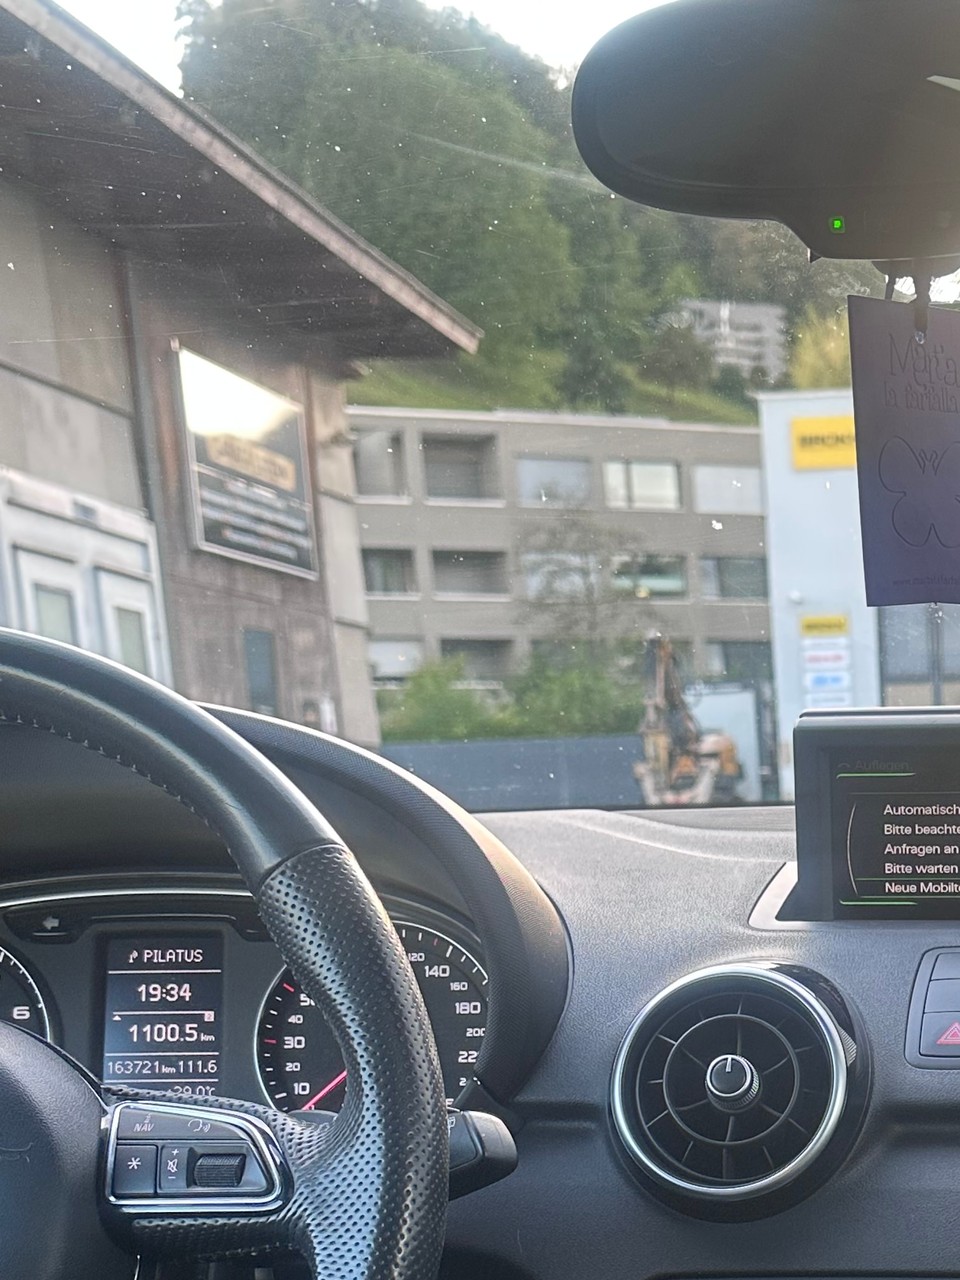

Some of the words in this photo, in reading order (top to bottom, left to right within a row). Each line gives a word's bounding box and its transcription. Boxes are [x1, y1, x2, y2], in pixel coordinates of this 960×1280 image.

[884, 824, 912, 834] Bitte
[884, 843, 940, 856] Anfragen
[943, 845, 959, 854] an
[884, 863, 912, 873] Bitte
[915, 864, 958, 873] warten
[885, 882, 917, 893] Neue
[144, 949, 203, 963] PILATUS
[408, 952, 425, 961] 120
[424, 965, 450, 978] 140
[450, 982, 468, 990] 160
[138, 984, 191, 1002] 19:34
[13, 1006, 30, 1019] 6
[455, 1002, 481, 1014] 180
[288, 1015, 303, 1024] 40
[129, 1024, 198, 1042] 1100.5
[201, 1033, 215, 1042] km
[284, 1036, 305, 1049] 30
[458, 1051, 480, 1063] 22
[178, 1060, 217, 1073] 111.6
[285, 1062, 301, 1071] 20
[293, 1082, 310, 1095] 10
[134, 1123, 154, 1132] NAV
